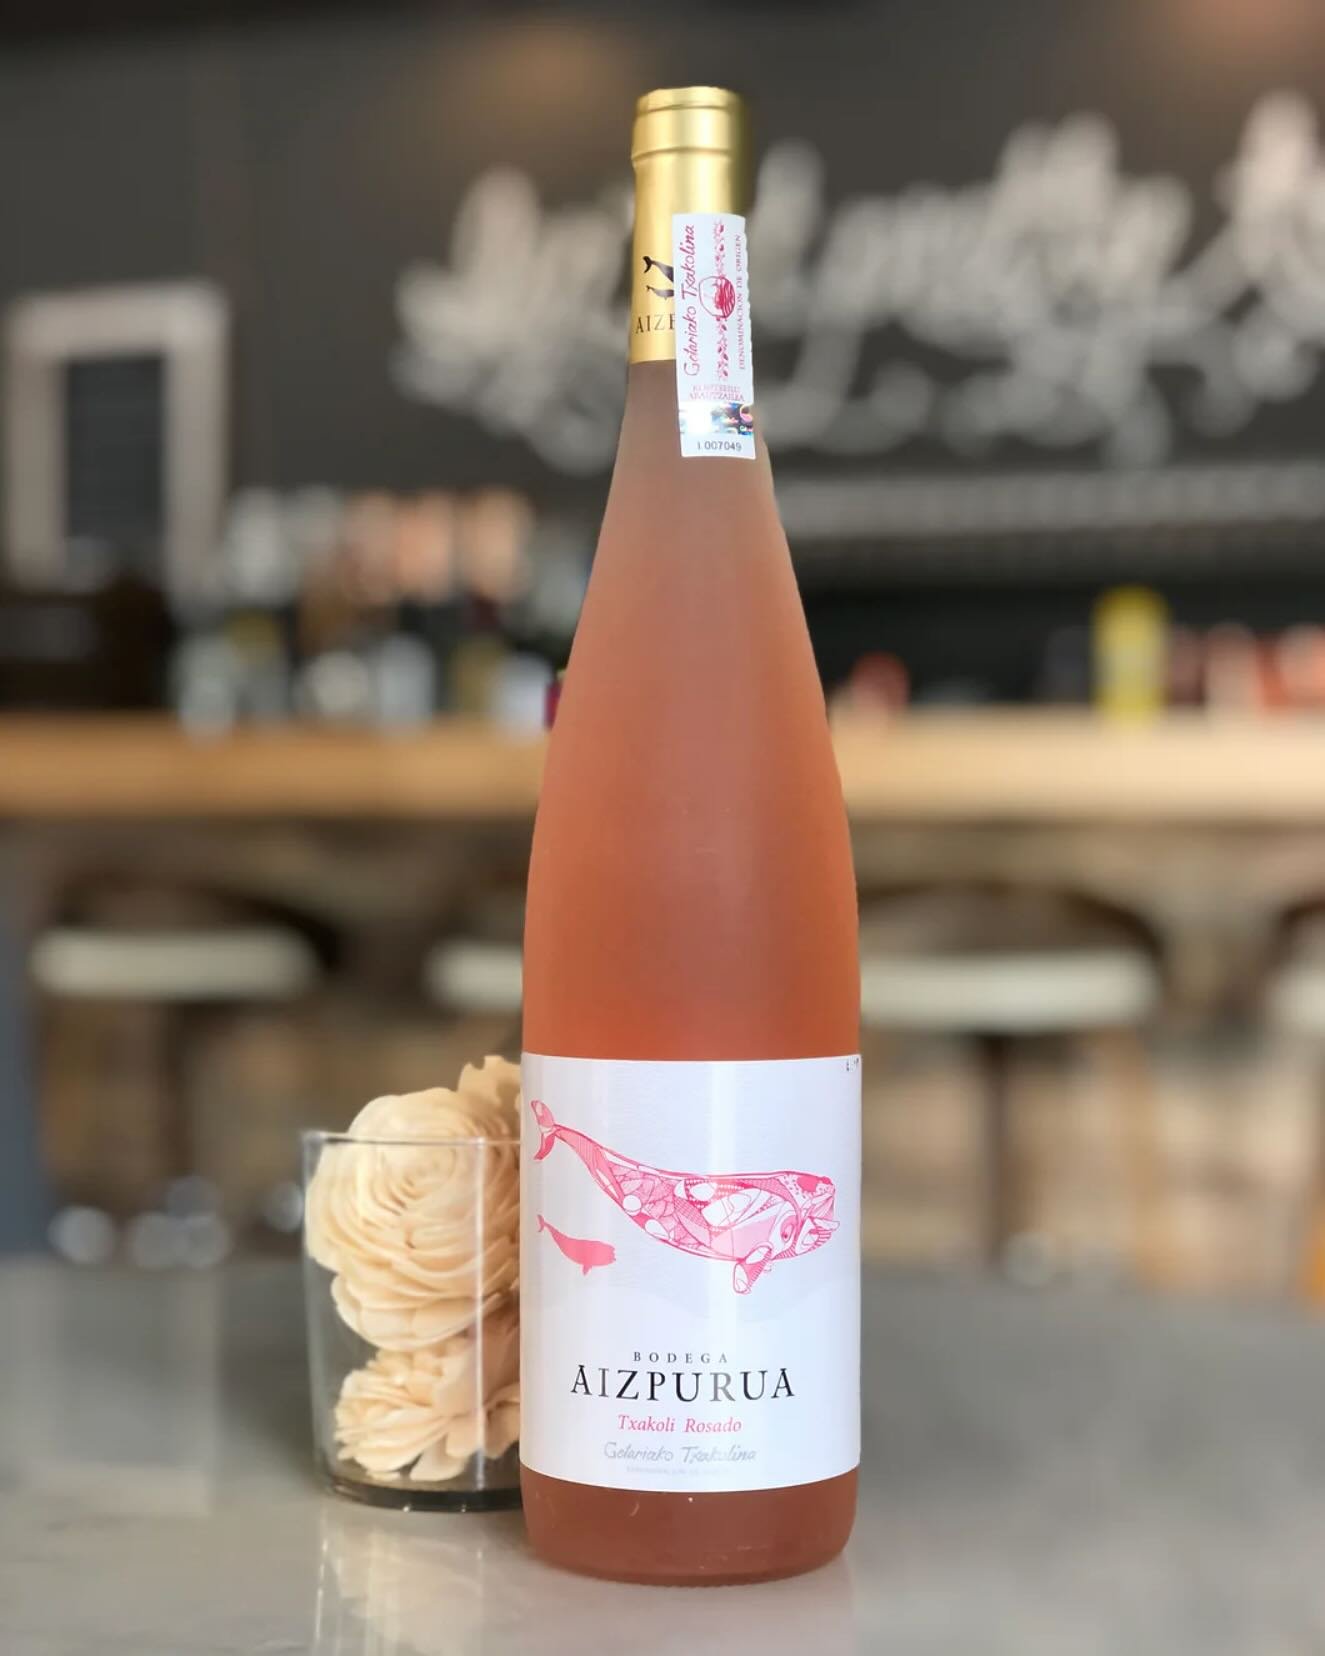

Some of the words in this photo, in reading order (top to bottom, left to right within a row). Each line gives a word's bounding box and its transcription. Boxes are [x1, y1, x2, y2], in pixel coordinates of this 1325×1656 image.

[680, 224, 697, 302] Txakolina
[704, 441, 742, 452] 007049
[633, 1351, 728, 1364] BODEGA
[570, 1364, 796, 1402] AIZPURUA
[617, 1414, 675, 1433] Txakoli
[684, 1416, 742, 1433] Rosado
